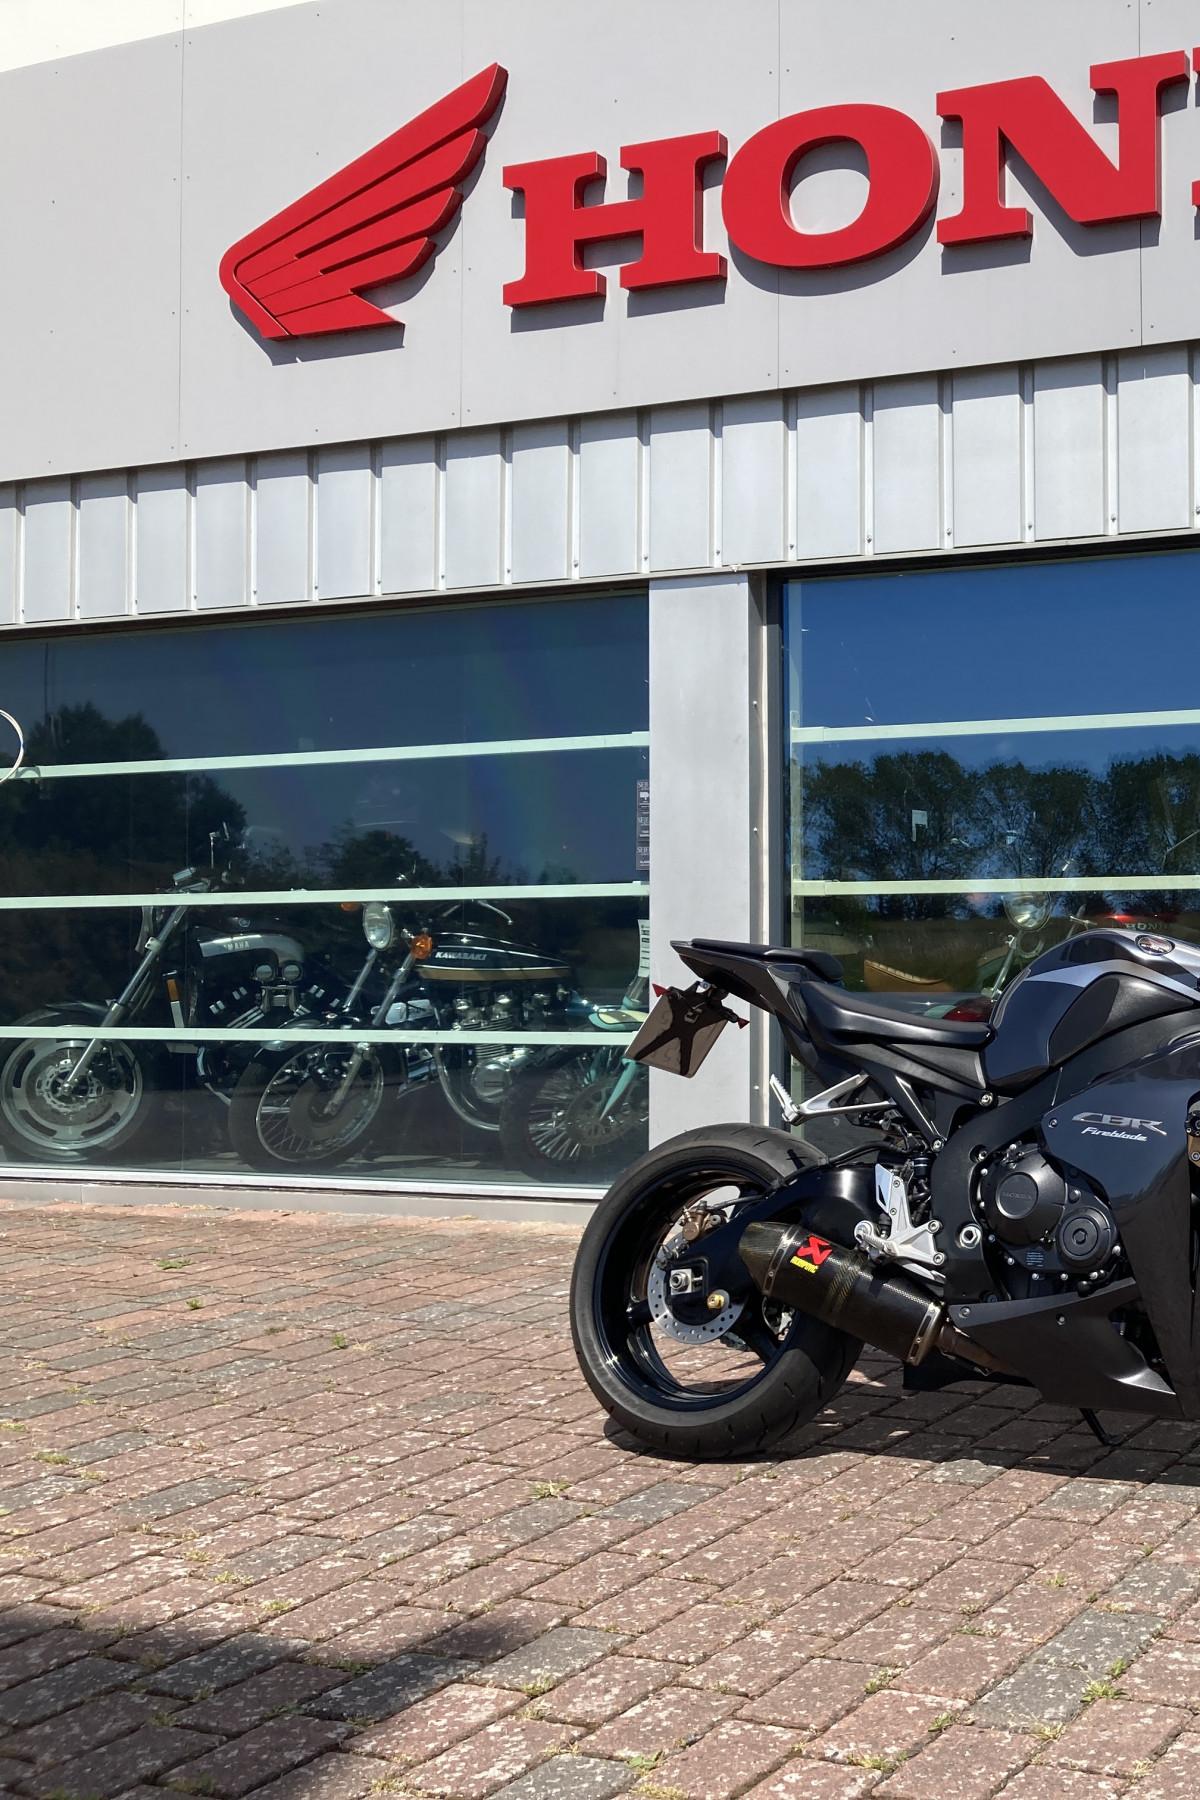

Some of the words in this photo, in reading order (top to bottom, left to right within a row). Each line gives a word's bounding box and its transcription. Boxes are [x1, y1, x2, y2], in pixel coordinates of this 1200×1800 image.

[435, 951, 487, 960] KAWASAKI
[1072, 1111, 1167, 1136] CBR
[1081, 1126, 1147, 1141] Fireblade
